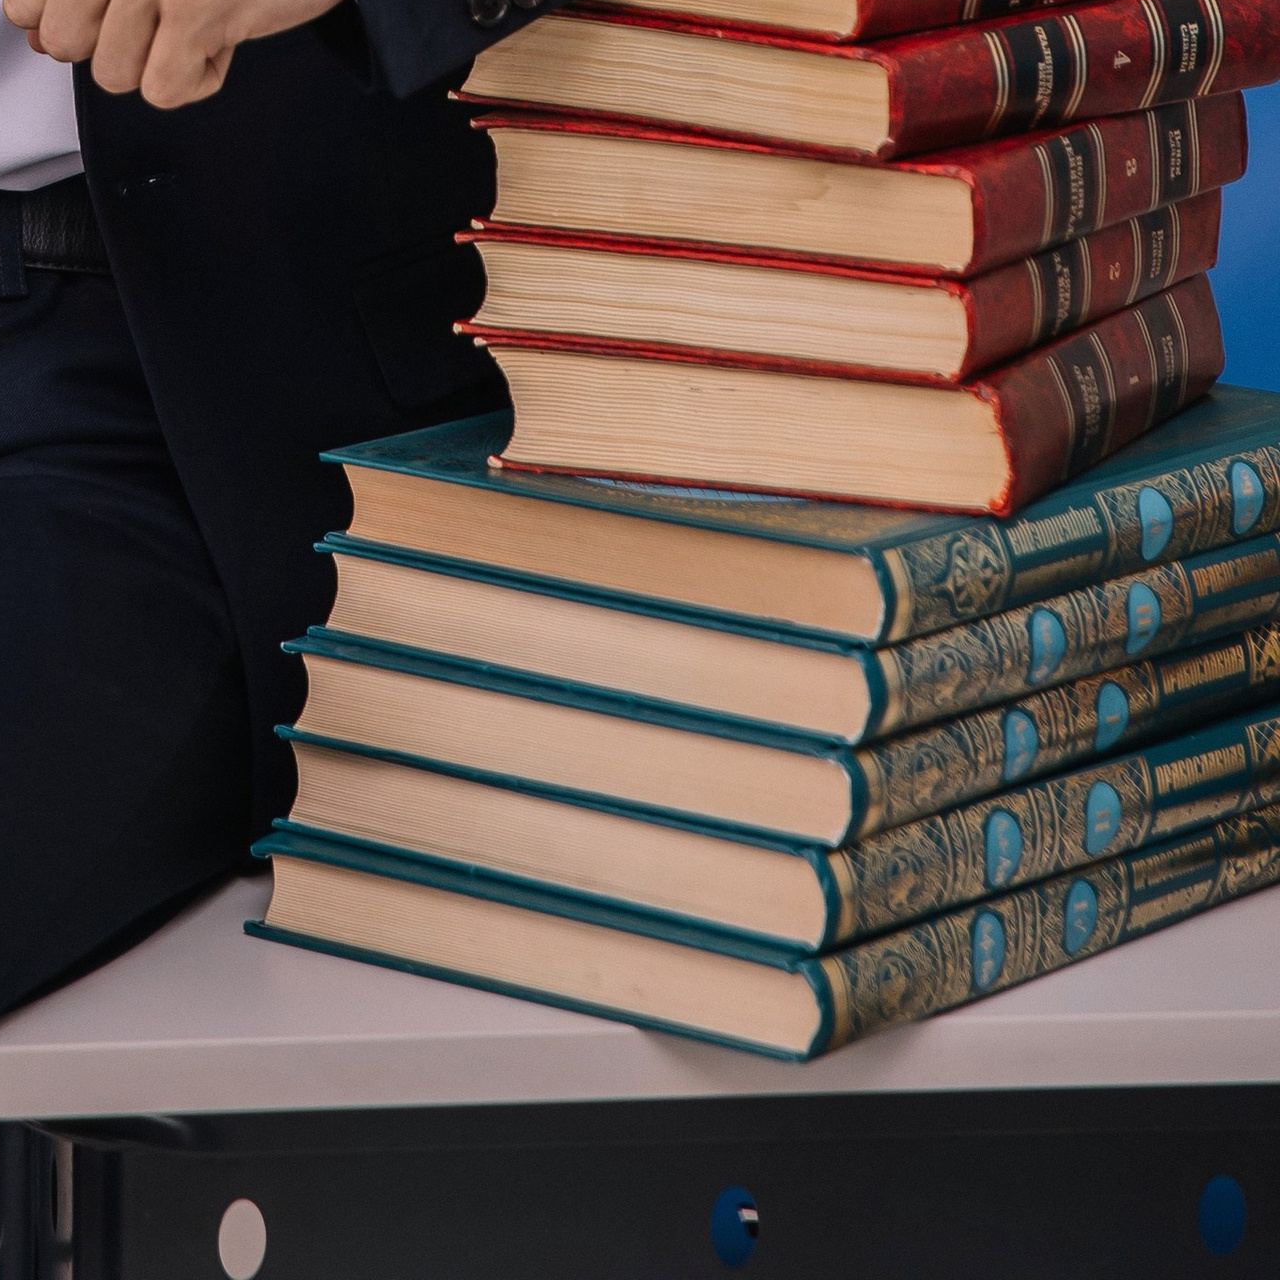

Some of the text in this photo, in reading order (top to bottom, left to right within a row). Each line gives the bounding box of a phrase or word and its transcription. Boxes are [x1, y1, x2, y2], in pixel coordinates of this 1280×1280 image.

[1114, 50, 1132, 70] 4
[1125, 157, 1138, 177] 3
[1109, 261, 1121, 281] 2
